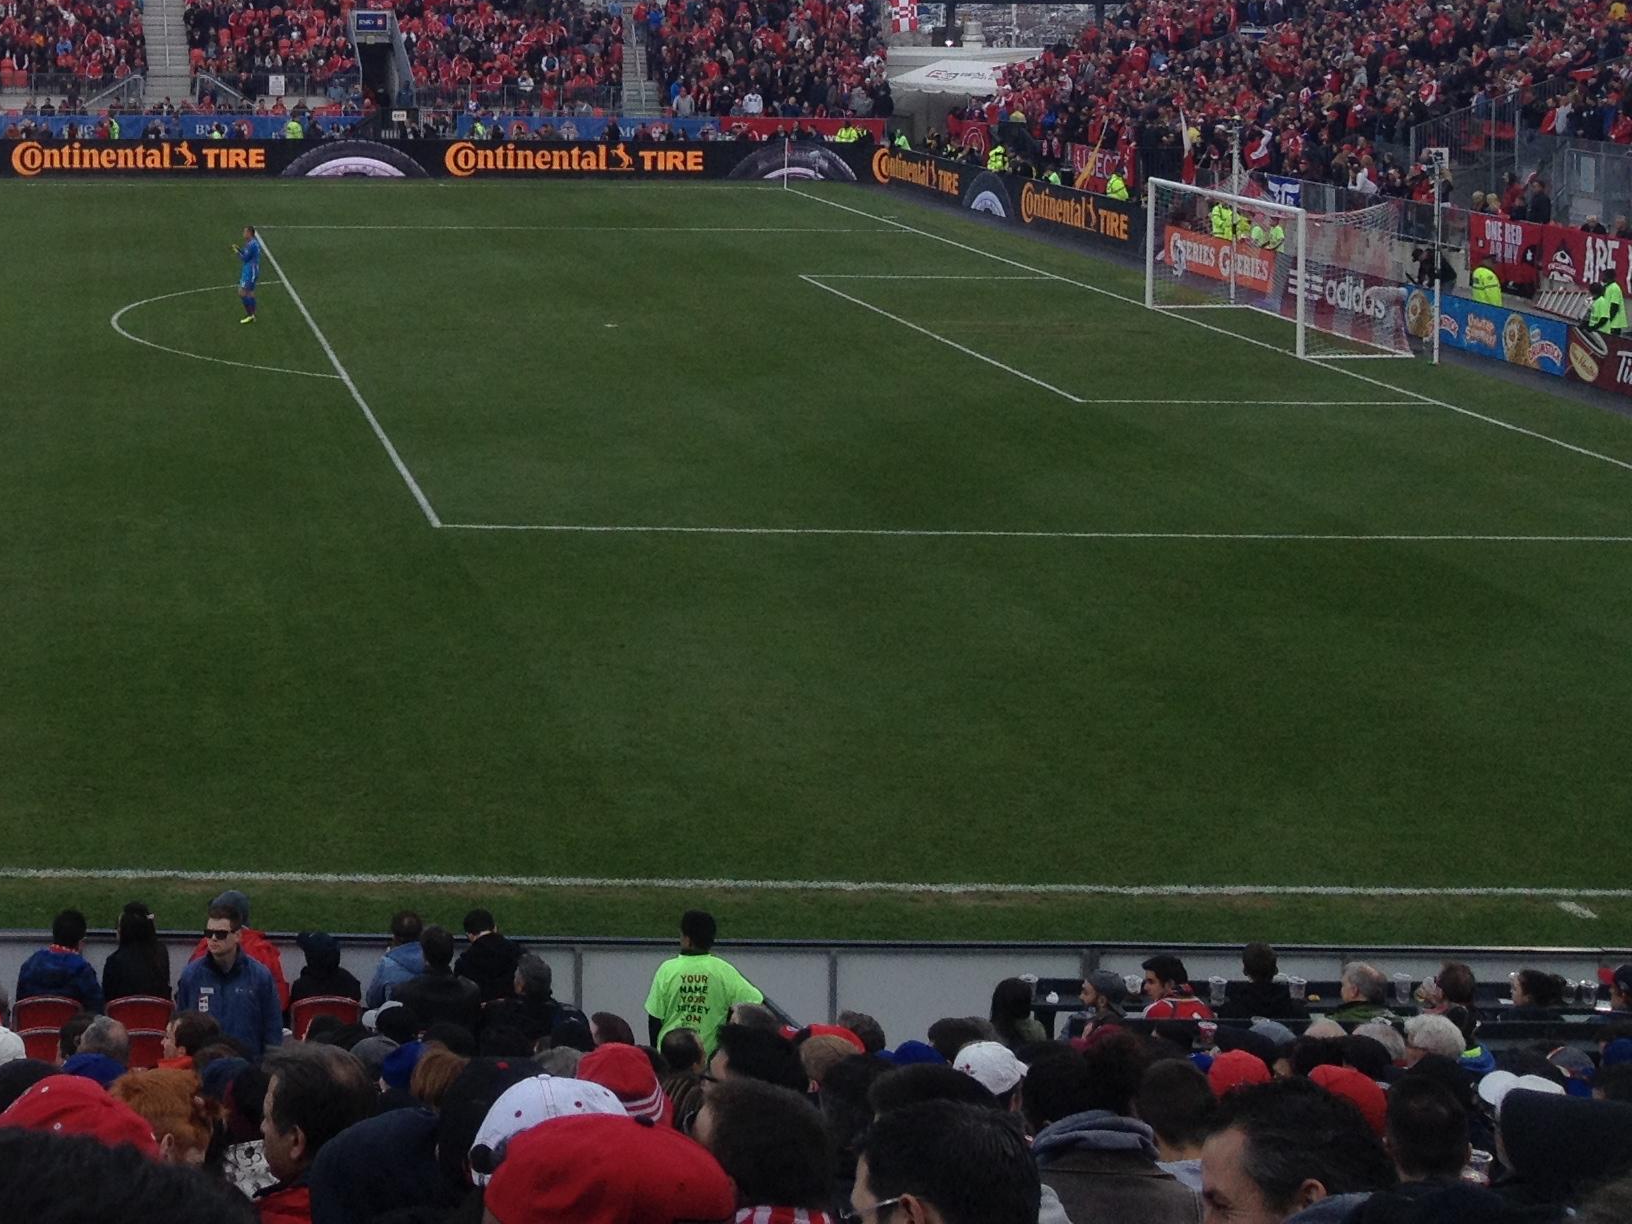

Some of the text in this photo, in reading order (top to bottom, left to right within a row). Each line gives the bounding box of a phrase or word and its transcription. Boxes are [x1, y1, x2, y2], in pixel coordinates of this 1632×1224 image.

[11, 140, 266, 176] Continental TIRE
[445, 142, 704, 176] Continental TIRE
[872, 147, 960, 196] Continental TIRE
[1021, 181, 1129, 241] Continental TIRE
[1325, 276, 1386, 319] adidas
[679, 985, 708, 994] NAME
[680, 974, 709, 984] YOUR
